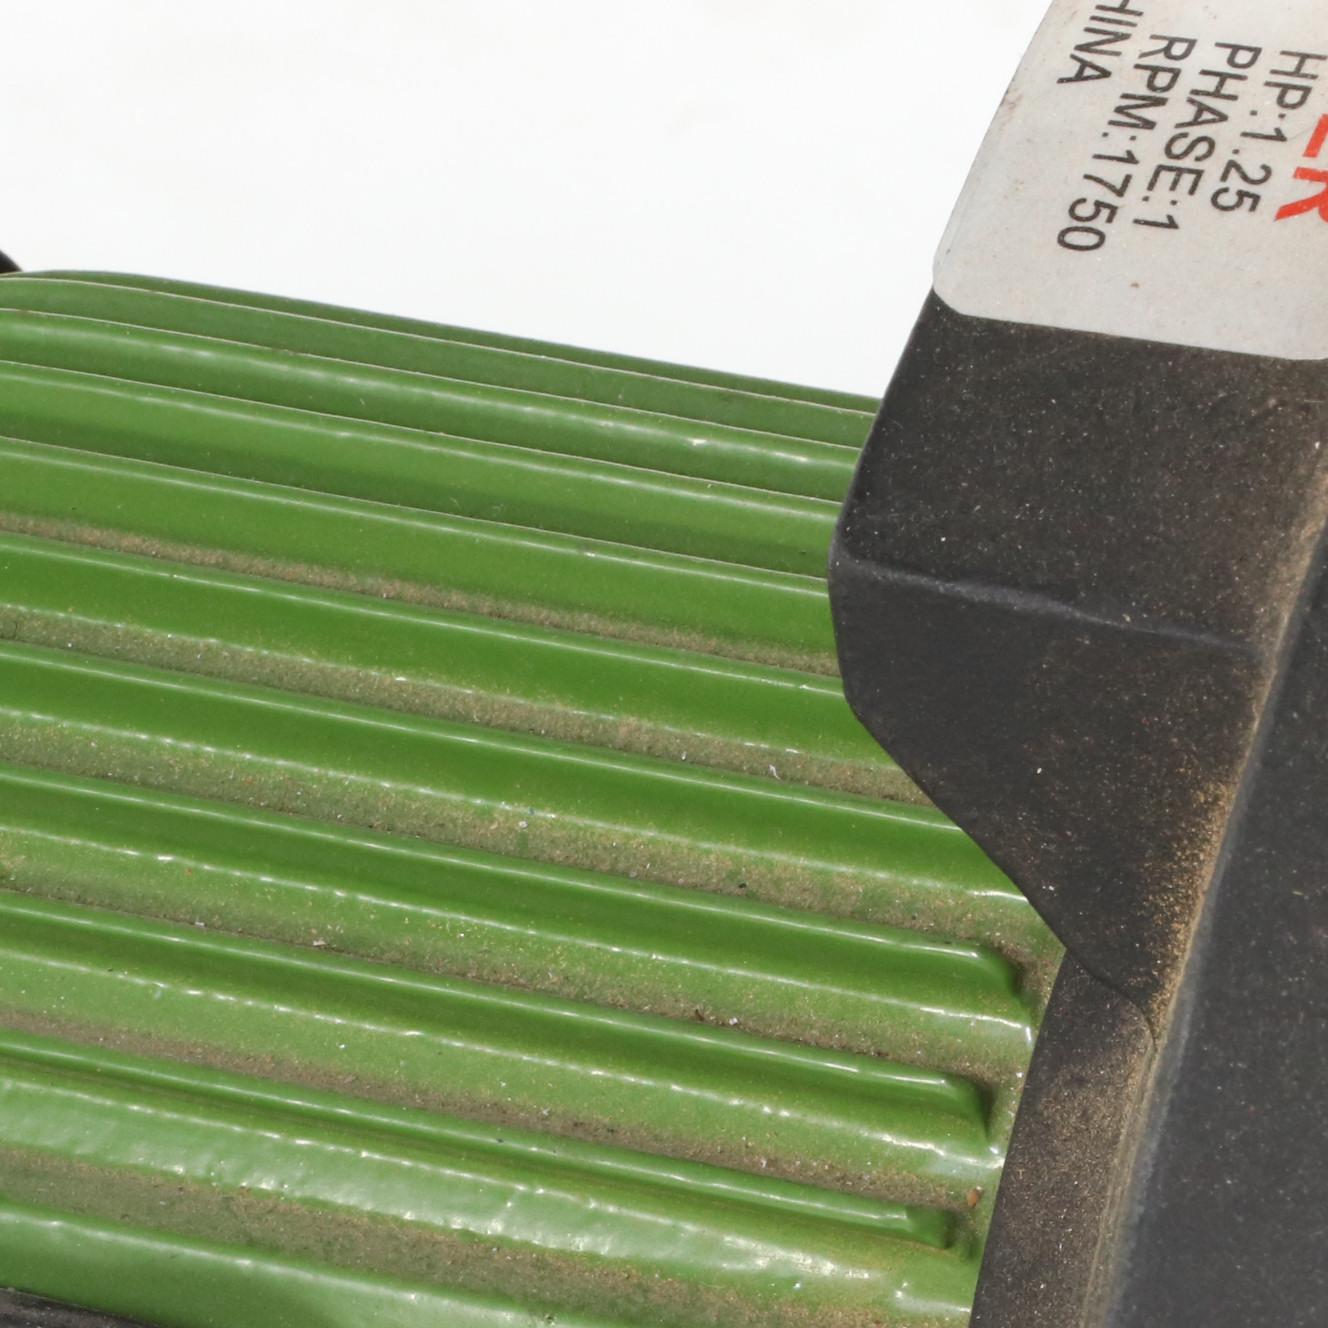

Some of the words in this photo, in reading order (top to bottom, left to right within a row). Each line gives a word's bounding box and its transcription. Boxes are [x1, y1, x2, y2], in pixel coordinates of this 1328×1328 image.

[1057, 34, 1197, 251] RPM:1750
[1133, 42, 1262, 230] PHASE:1
[1210, 50, 1327, 213] HP:1.25
